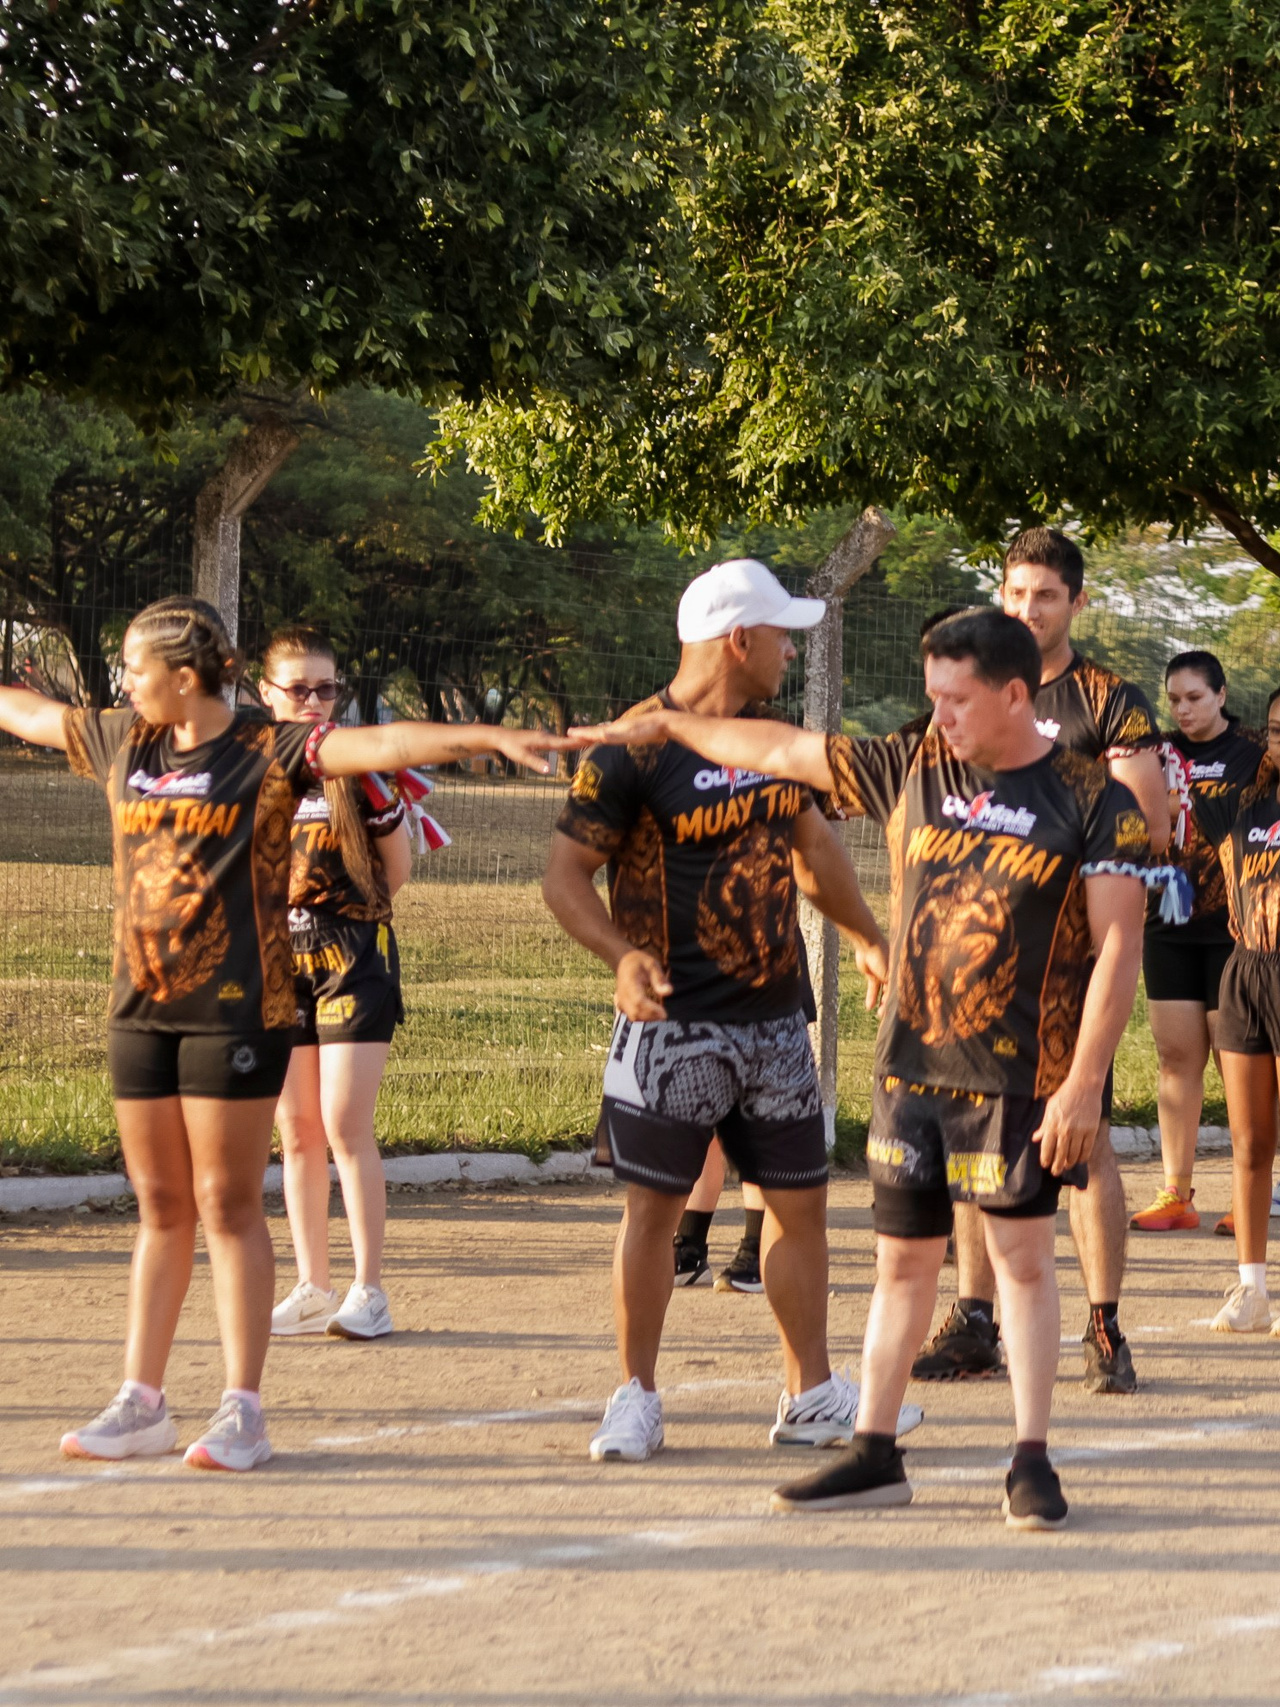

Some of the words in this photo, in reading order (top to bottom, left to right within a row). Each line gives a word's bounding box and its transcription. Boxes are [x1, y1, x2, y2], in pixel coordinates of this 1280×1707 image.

[168, 798, 240, 838] THAI
[672, 789, 755, 844] MUAY
[905, 824, 984, 868] MUAY
[982, 835, 1062, 889] THAI
